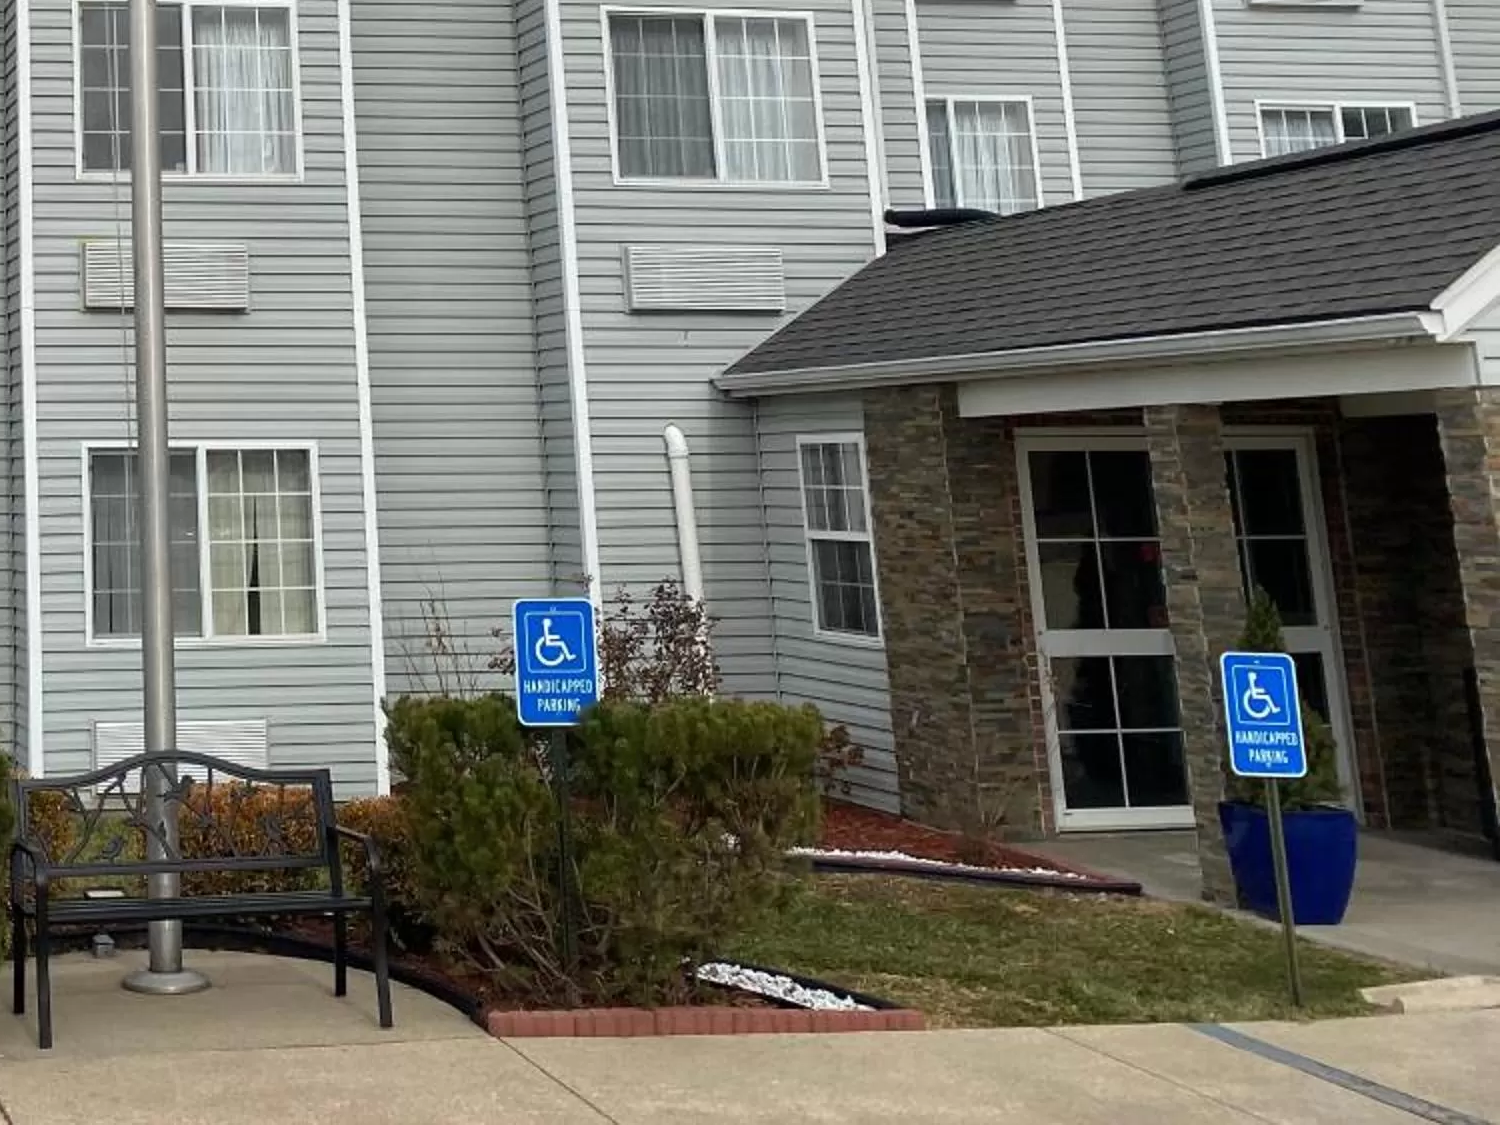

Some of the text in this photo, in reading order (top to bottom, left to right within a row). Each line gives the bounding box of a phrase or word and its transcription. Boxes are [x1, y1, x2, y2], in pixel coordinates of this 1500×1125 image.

[523, 678, 593, 694] HANDICAPPED
[537, 698, 581, 713] PARKING
[1235, 730, 1299, 746] HANDICAPPED
[1248, 748, 1289, 764] PARKING
